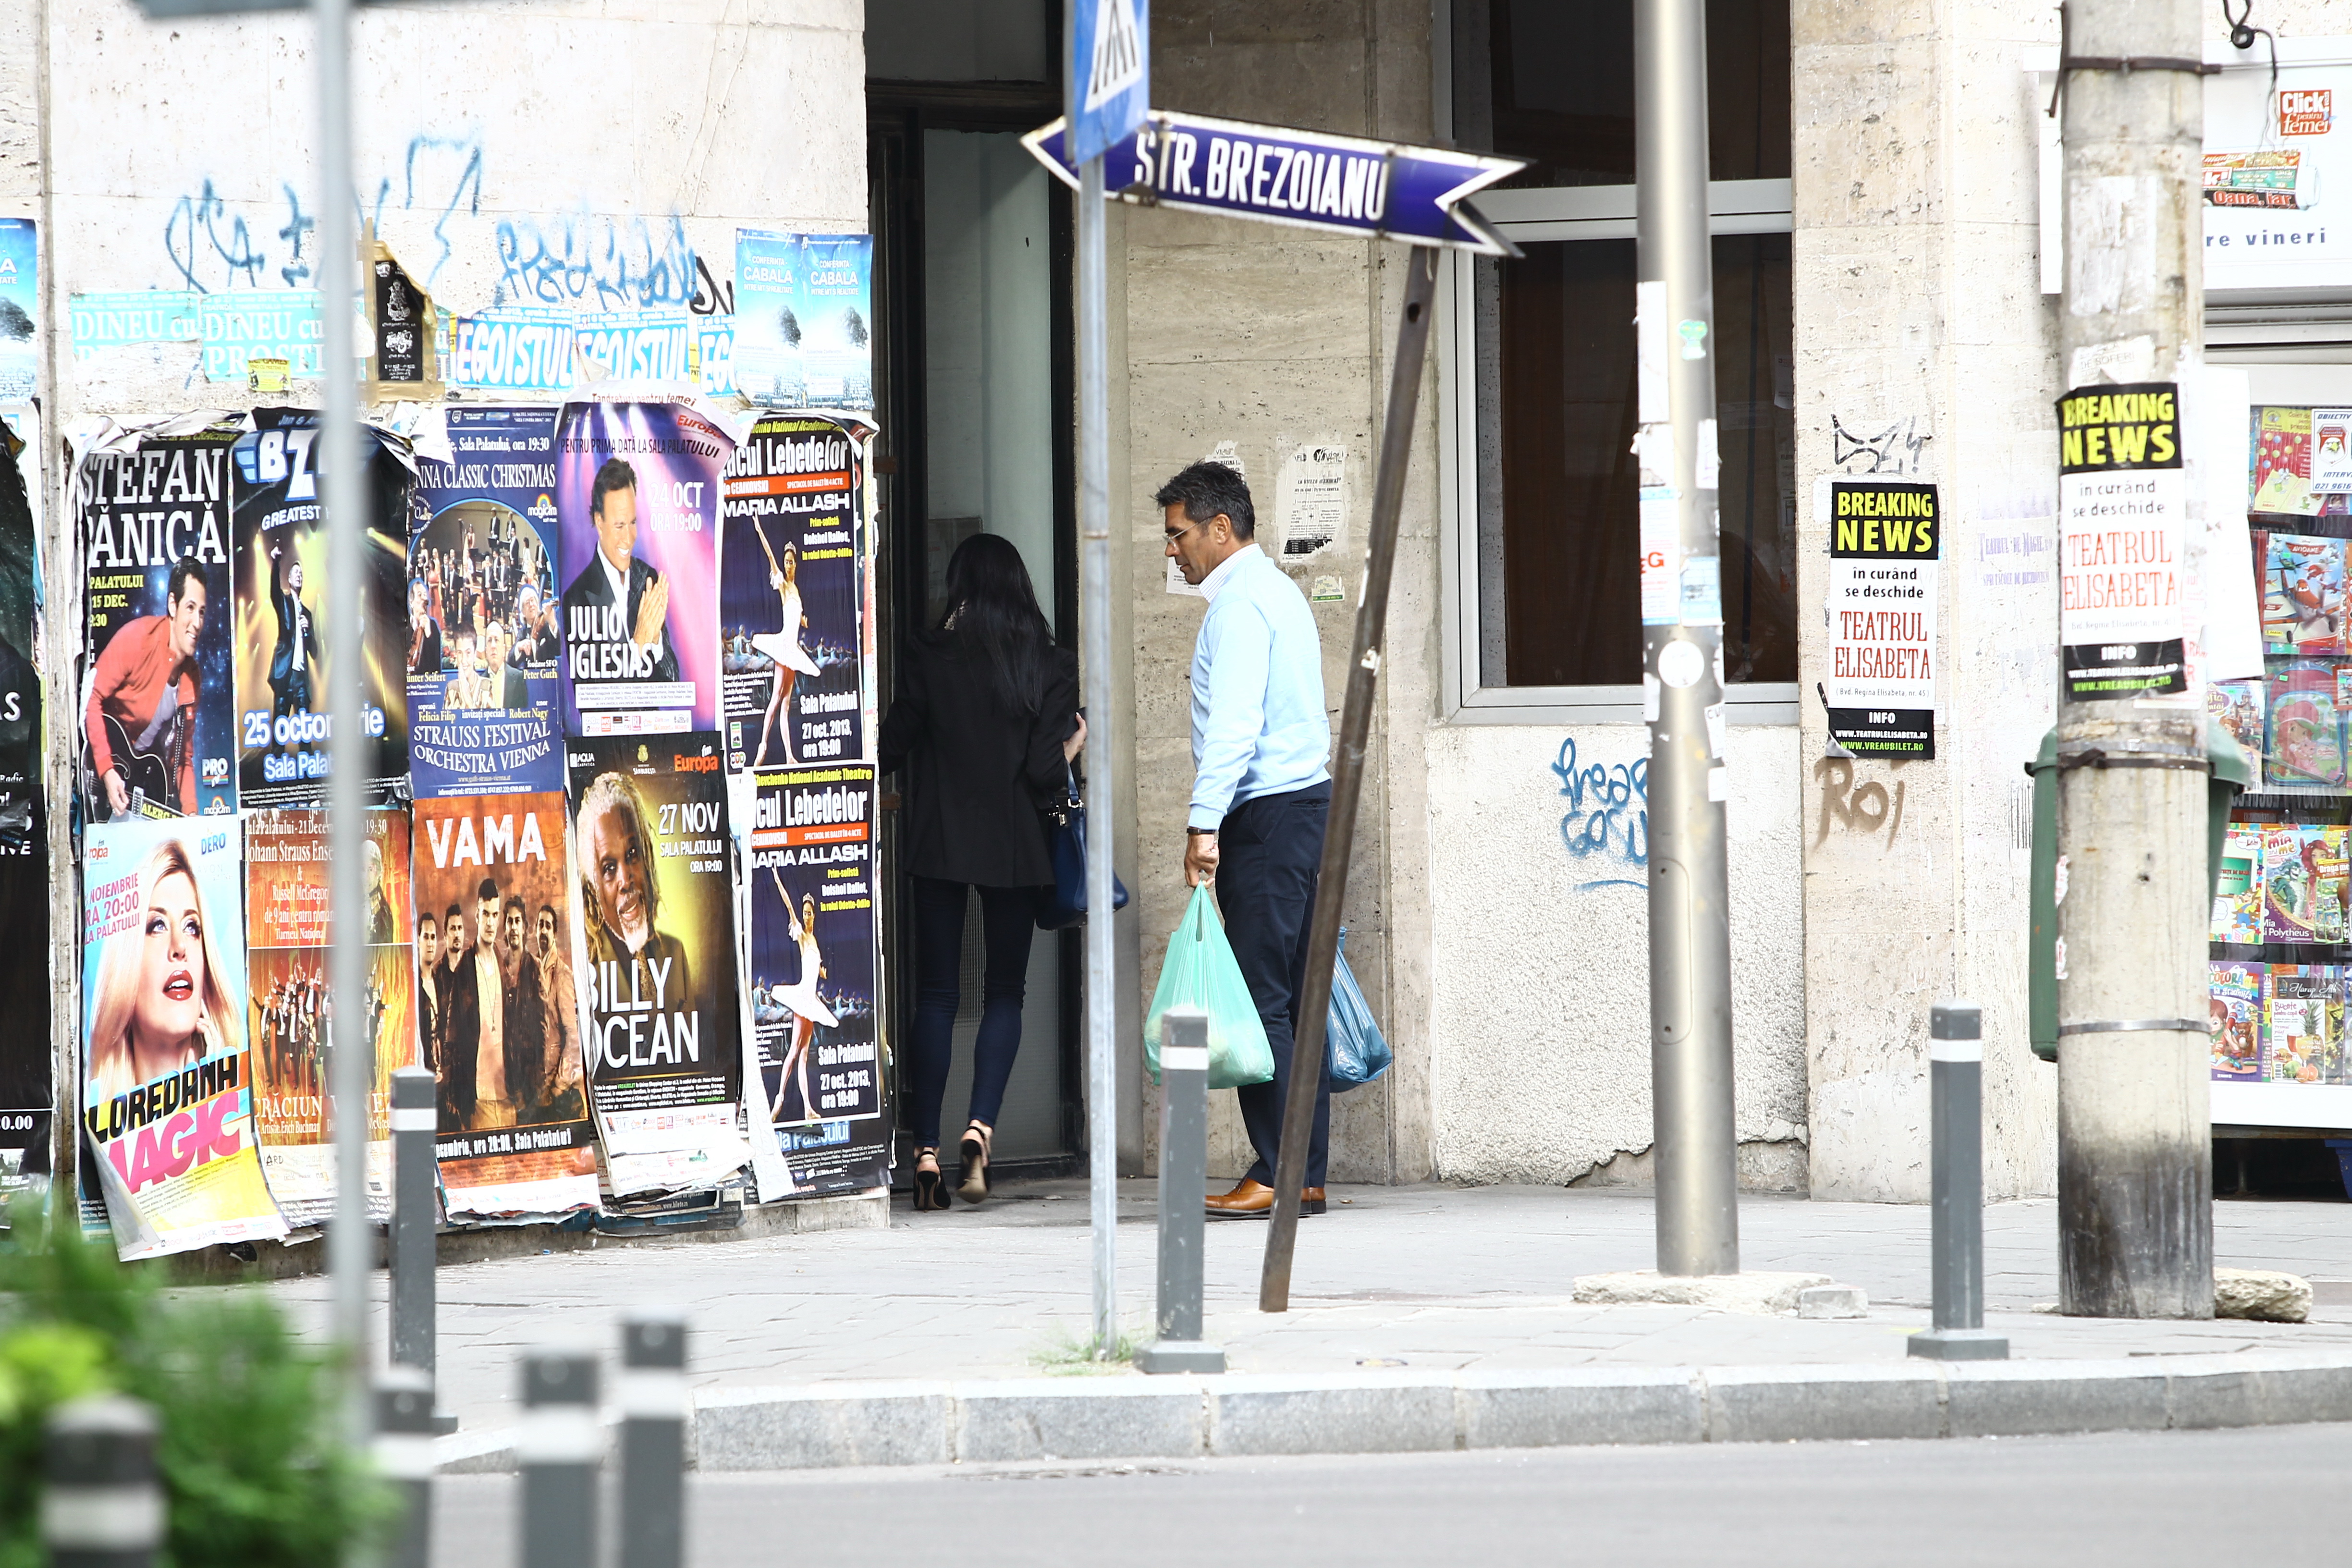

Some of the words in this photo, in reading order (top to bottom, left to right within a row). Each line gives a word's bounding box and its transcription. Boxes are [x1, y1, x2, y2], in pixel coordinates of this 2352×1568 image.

[2282, 113, 2329, 134] femei
[2297, 112, 2322, 121] pentru
[1134, 131, 1201, 197] STR.
[1207, 138, 1389, 221] BREZOIANU
[2213, 191, 2265, 206] Oana,
[2266, 191, 2291, 207] iar
[2246, 227, 2326, 246] vineri
[743, 266, 793, 284] CABALA
[810, 271, 858, 285] CABALA
[74, 310, 165, 341] DINEU
[170, 318, 200, 338] cu
[203, 312, 292, 342] DINEU
[298, 319, 325, 339] cu
[456, 322, 572, 386] EGOISTUL
[666, 392, 698, 407] femei
[2063, 392, 2174, 427] BREAKING
[676, 415, 722, 439] Europa
[772, 420, 799, 432] National
[459, 436, 475, 451] Sala
[476, 436, 511, 453] Palatului,
[513, 441, 526, 451] ora
[528, 437, 550, 451] 19:30
[561, 438, 589, 453] PENTRU
[591, 438, 615, 453] PRIMA
[618, 436, 636, 453] DATĂ
[638, 439, 647, 453] LA
[649, 438, 666, 454] SALA
[667, 438, 720, 458] PALATULUI
[767, 434, 848, 475] Lebedelor
[2062, 425, 2176, 466] NEWS
[443, 464, 488, 489] CLASSIC
[491, 464, 556, 489] CHRISTMAS
[650, 482, 670, 508] 24
[672, 482, 704, 508] OCT
[730, 480, 769, 494] CEAIKOVSKI
[2080, 481, 2092, 497] în
[2098, 479, 2156, 495] curând
[723, 498, 778, 517] MARIA
[780, 492, 850, 514] ALLASH
[1838, 491, 1934, 518] BREAKING
[2073, 507, 2086, 517] se
[2091, 502, 2165, 517] deschide
[262, 505, 321, 531] GREATEST
[650, 512, 671, 532] ORA
[673, 512, 702, 532] 19:00
[804, 532, 827, 546] Bolshoi
[828, 531, 850, 544] Ballet,
[1837, 519, 1933, 553] NEWS
[2068, 530, 2172, 567] TEATRUL
[90, 575, 144, 589] PALATULUI
[1853, 567, 1866, 580] în
[1871, 567, 1917, 580] curând
[103, 594, 128, 608] DEC.
[1845, 588, 1859, 598] se
[1863, 585, 1924, 598] deschide
[2064, 571, 2178, 611] ELISABETA
[567, 603, 623, 642] JULIO
[1840, 611, 1927, 641] TEATRUL
[569, 643, 653, 679] IGLESIAS
[1834, 647, 1931, 679] ELISABETA
[2101, 646, 2137, 661] INFO
[425, 671, 446, 682] Seifert
[523, 669, 539, 679] Peter
[540, 668, 558, 679] Guth
[800, 694, 819, 715] Sala
[819, 690, 858, 712] Palatului
[1855, 688, 1875, 698] Regina
[1877, 688, 1907, 698] Elisabeta,
[418, 711, 439, 722] Felicia
[441, 710, 455, 723] Filip
[462, 709, 483, 721] invitați
[483, 709, 505, 721] speciali
[509, 708, 530, 719] Robert
[531, 708, 549, 721] Nagy
[1869, 711, 1896, 724] INFO
[244, 711, 270, 746] 25
[414, 725, 480, 748] STRAUSS
[484, 722, 551, 747] FESTIVAL
[802, 722, 812, 740] 27
[813, 722, 829, 739] oct.
[829, 718, 852, 737] 2013,
[1835, 730, 1928, 739] WWW.TEATRULELISABETA.RO
[701, 745, 712, 757] fm
[802, 743, 817, 759] ora
[818, 738, 841, 757] 19:00
[1840, 741, 1924, 751] WWW.VREAUBILET.RO
[265, 752, 296, 781] Sala
[414, 745, 497, 773] ORCHESTRA
[499, 740, 551, 771] VIENNA
[674, 755, 720, 774] Europa
[202, 758, 229, 776] PRO
[788, 770, 813, 784] National
[813, 769, 842, 784] Academic
[842, 768, 873, 781] Theatre
[785, 785, 868, 826] Lebedelor
[260, 821, 294, 835] Palatului
[366, 819, 387, 835] 19:30
[659, 804, 677, 835] 27
[682, 802, 720, 833] NOV
[426, 812, 547, 868] VAMA
[830, 831, 842, 839] BALET
[851, 829, 862, 837] ACTE
[201, 833, 227, 856] DERO
[279, 840, 310, 862] Strauss
[659, 842, 679, 857] SALA
[680, 839, 722, 856] PALATULUI
[798, 843, 868, 866] ALLASH
[690, 861, 704, 873] ORA
[705, 860, 723, 872] 19:00
[2319, 865, 2339, 873] Draga
[90, 872, 139, 904] NOIEMBRIE
[272, 884, 295, 900] Russell
[296, 884, 328, 905] McGregor
[821, 883, 846, 897] Bolshoi
[847, 882, 869, 894] Ballet,
[104, 891, 139, 920] 20:00
[265, 906, 272, 923] de
[97, 912, 140, 941] PALATULUI
[2264, 919, 2276, 927] Mia
[276, 928, 298, 940] Turneu
[2269, 928, 2309, 939] Polytheus
[2214, 986, 2220, 994] la
[2290, 982, 2316, 998] Harap
[2275, 1002, 2297, 1011] Bucate
[818, 1044, 837, 1067] Sala
[837, 1041, 874, 1064] Palatului
[821, 1073, 830, 1090] 27
[831, 1073, 847, 1090] oct.
[847, 1069, 870, 1089] 2013,
[821, 1094, 836, 1109] ora
[837, 1090, 859, 1108] 19:00
[473, 1140, 486, 1154] ora
[487, 1134, 514, 1153] 20:00,
[514, 1131, 531, 1151] Sala
[532, 1127, 572, 1149] Palatului
